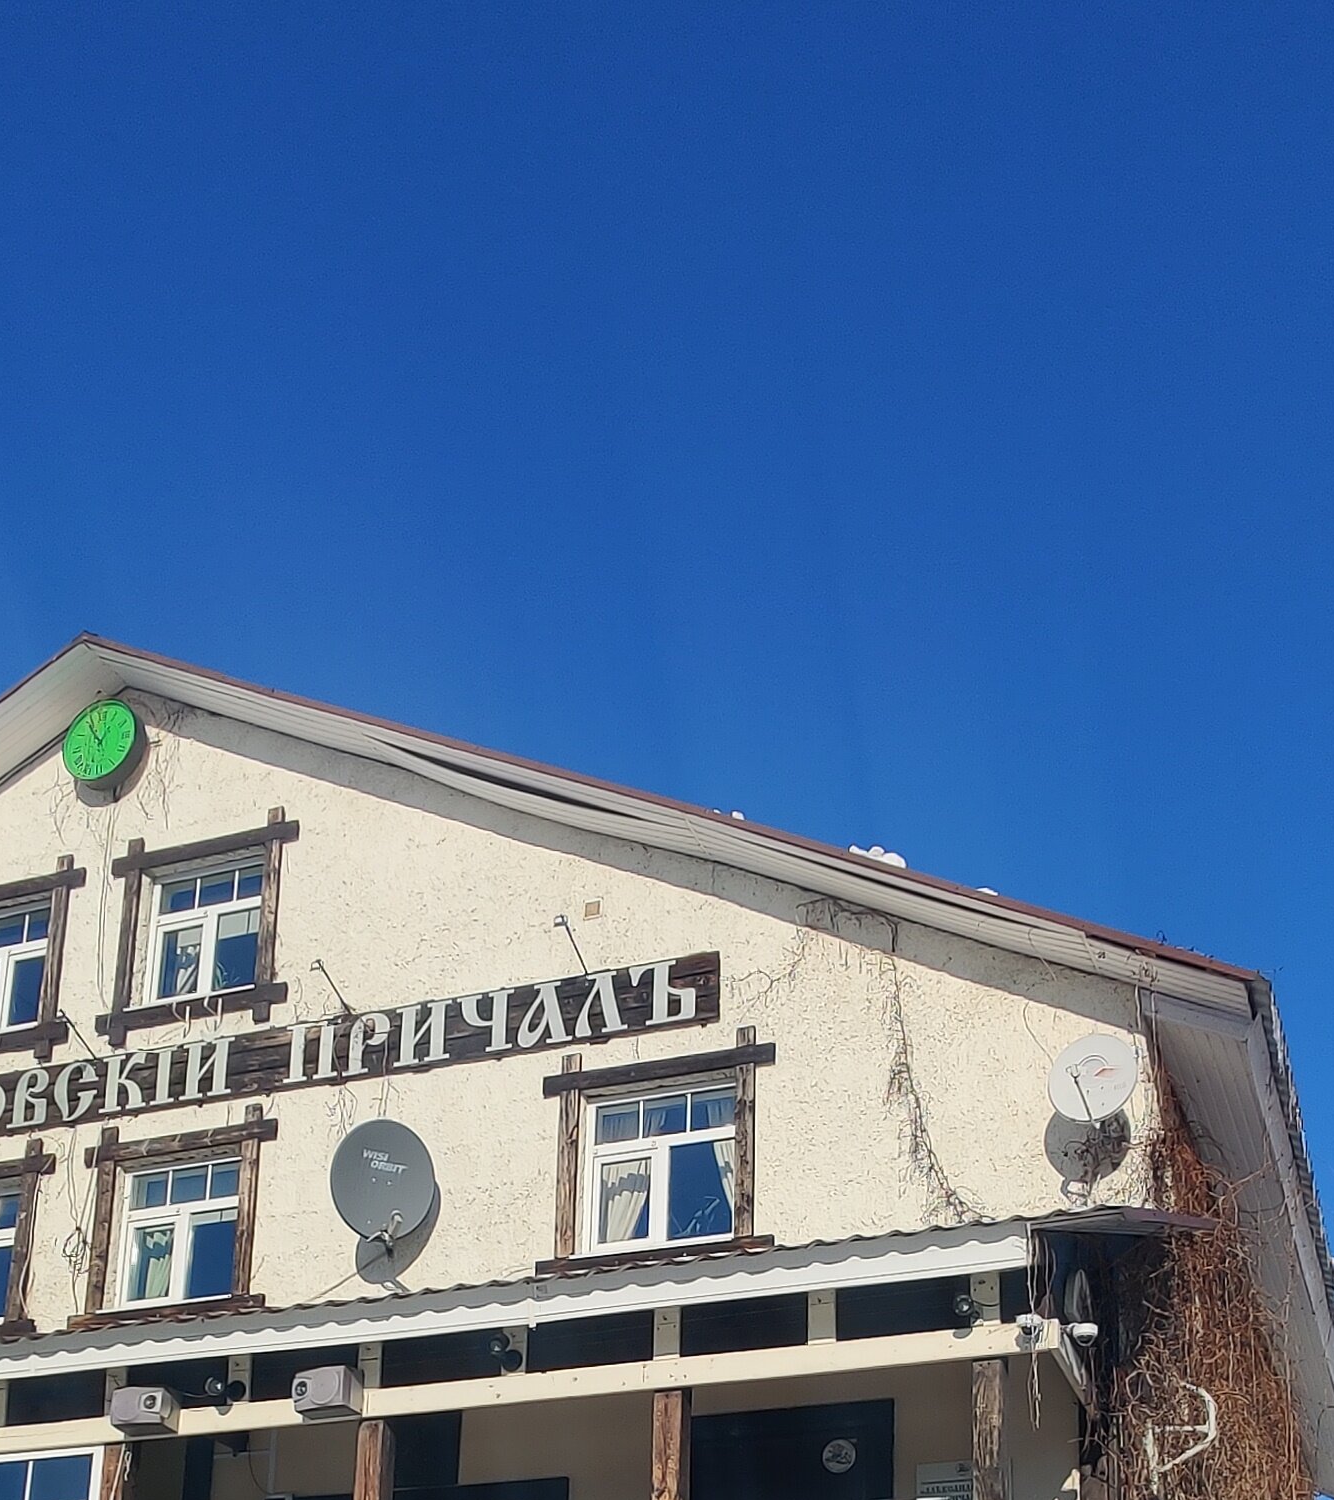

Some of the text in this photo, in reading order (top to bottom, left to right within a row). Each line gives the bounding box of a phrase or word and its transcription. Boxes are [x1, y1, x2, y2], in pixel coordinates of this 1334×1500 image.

[283, 960, 697, 1084] ПРИЧАЛЪ
[362, 1148, 389, 1161] WISI
[370, 1160, 408, 1174] ORBIT
